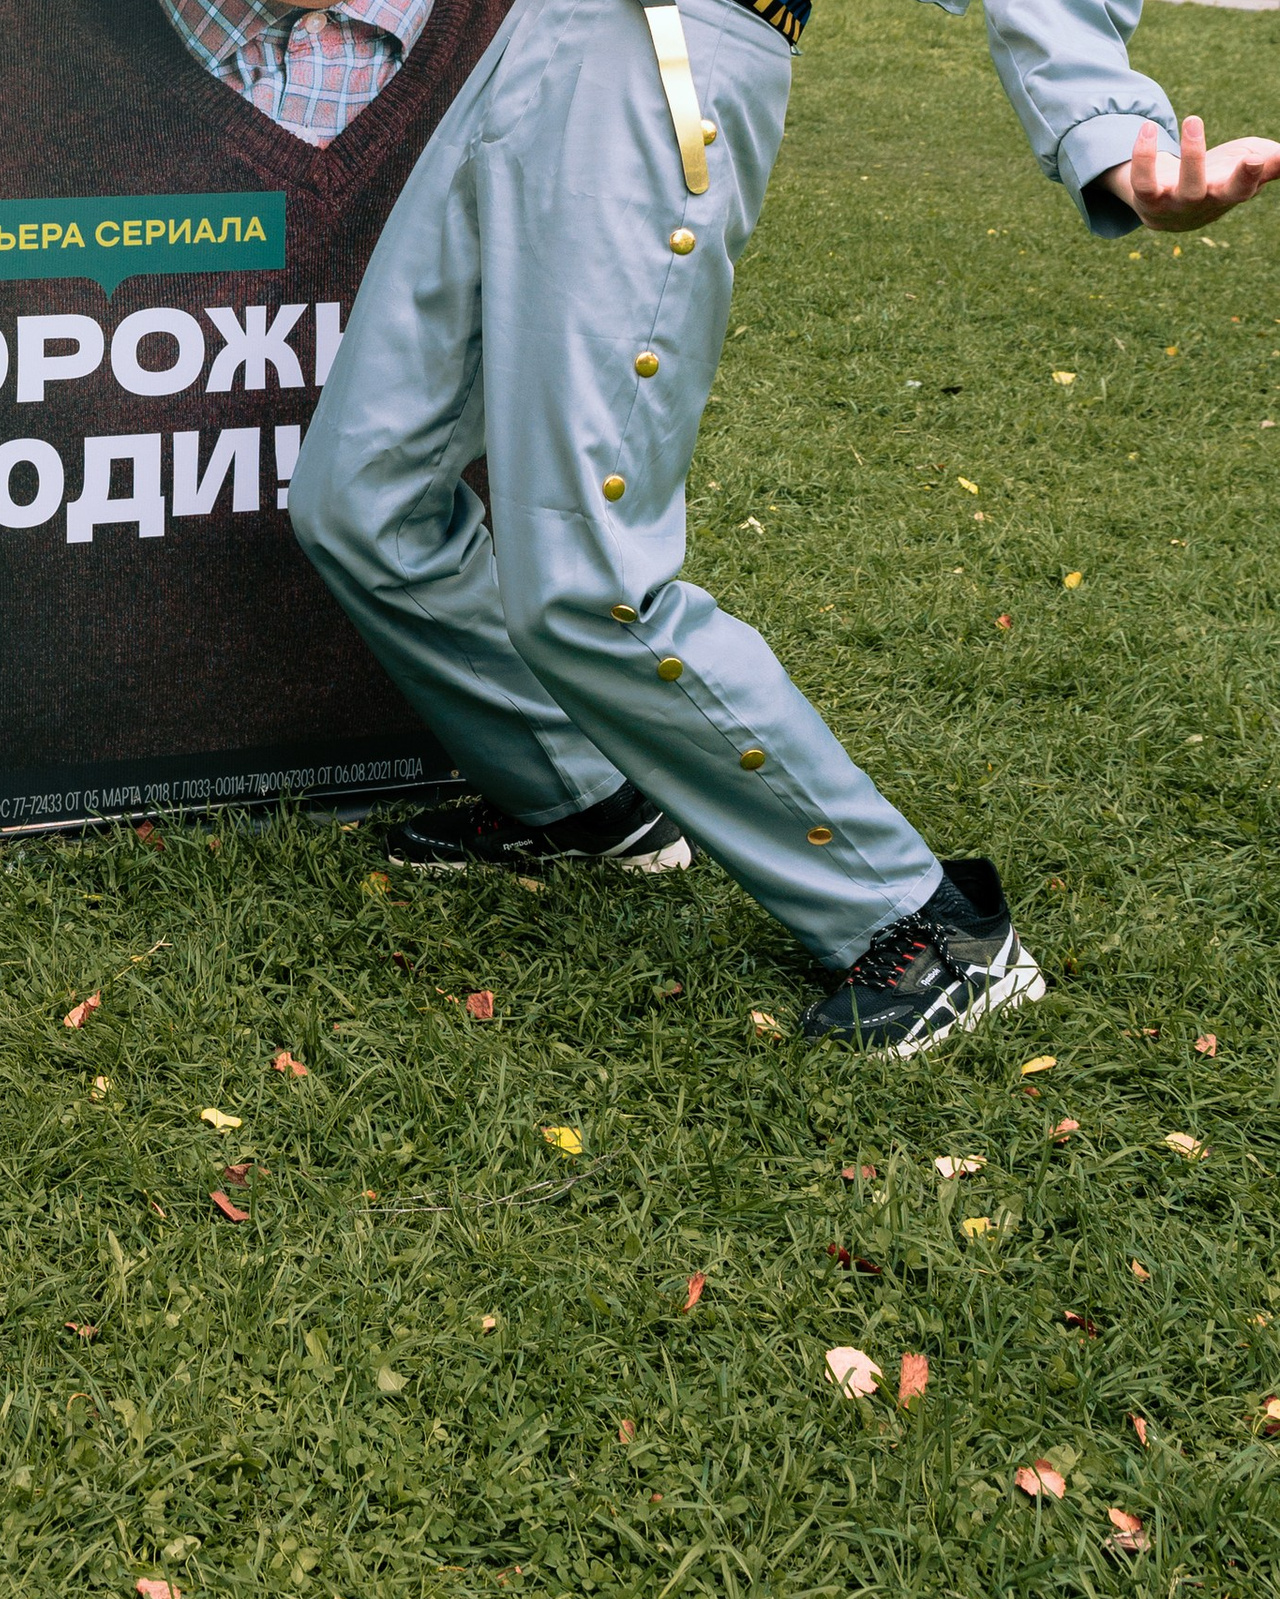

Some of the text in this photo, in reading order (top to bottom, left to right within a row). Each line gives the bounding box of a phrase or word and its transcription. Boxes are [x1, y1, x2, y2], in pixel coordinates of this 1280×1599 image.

[94, 215, 267, 248] СЕРИАЛА
[12, 792, 63, 819] 77-72433
[65, 791, 81, 811] ОТ
[83, 789, 99, 810] 05
[102, 785, 142, 808] МАРТА
[144, 782, 170, 804] 2018
[317, 765, 333, 785] ОТ
[334, 760, 391, 784] 06.08.2021
[394, 757, 424, 780] ГОДА
